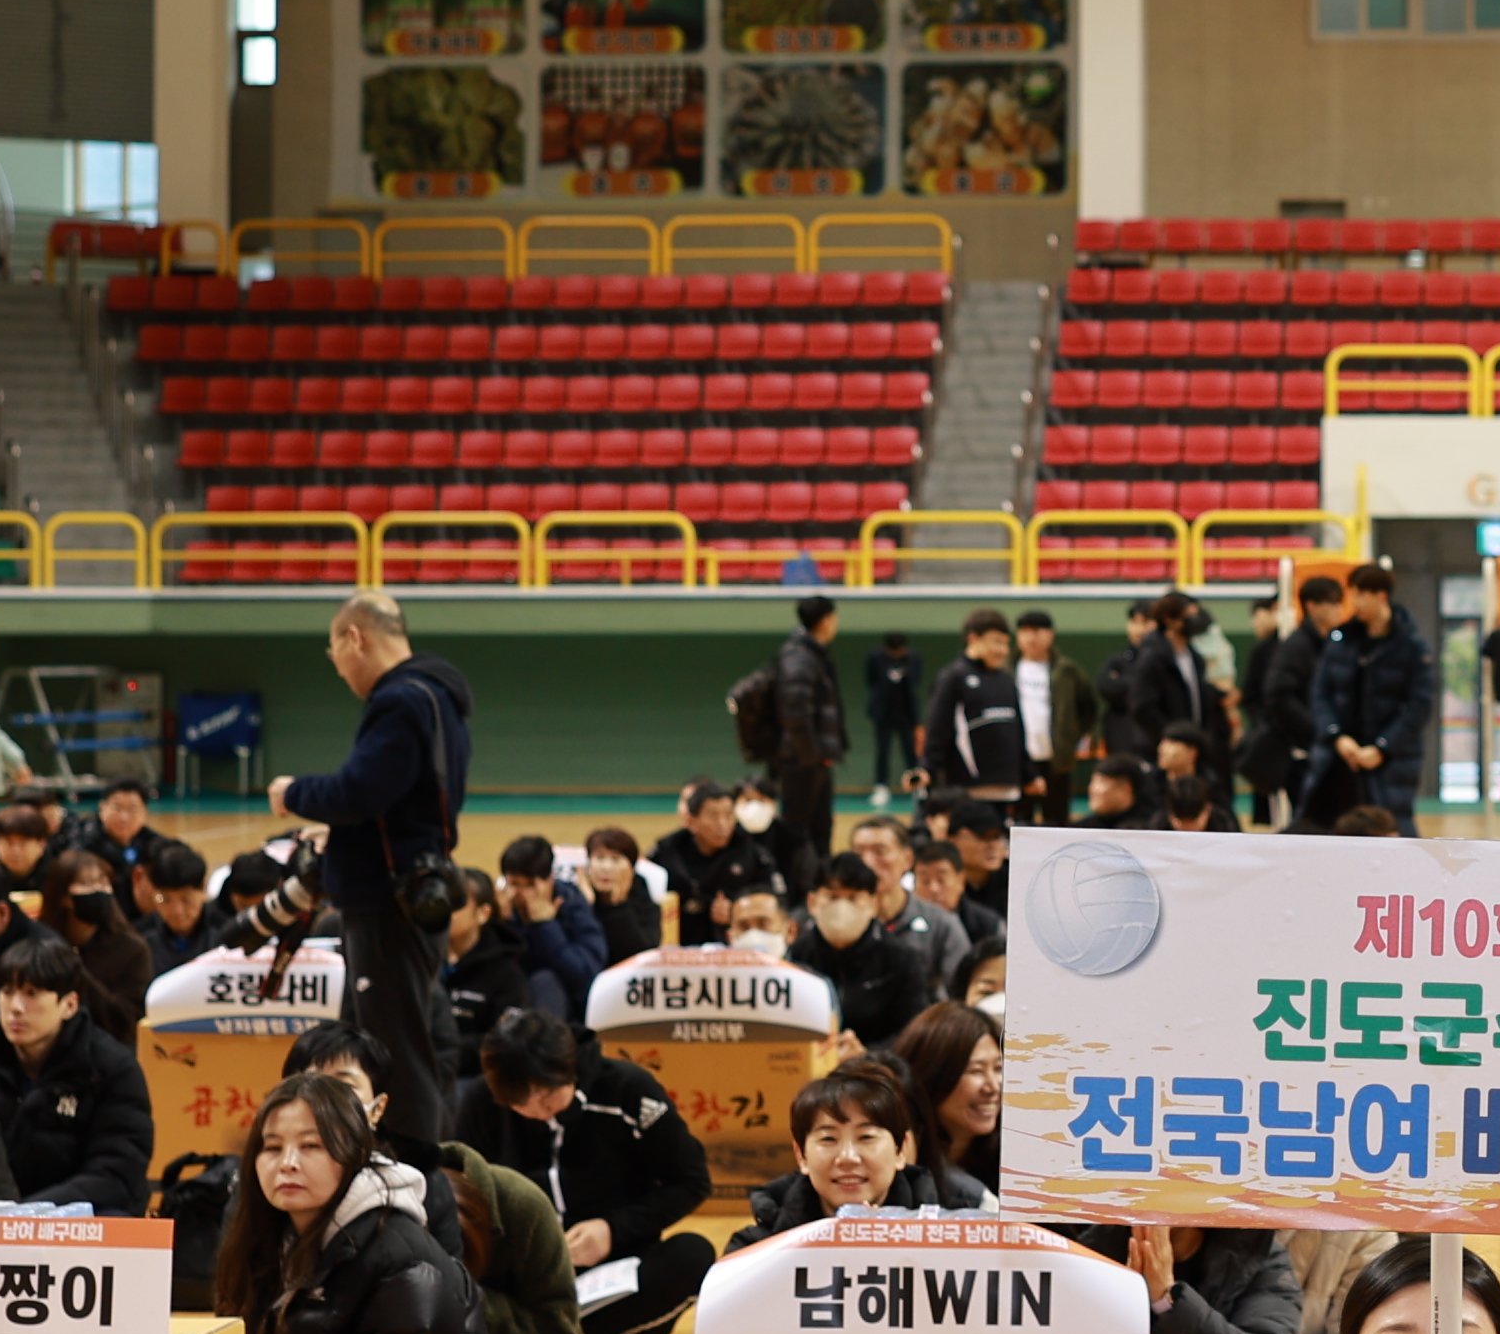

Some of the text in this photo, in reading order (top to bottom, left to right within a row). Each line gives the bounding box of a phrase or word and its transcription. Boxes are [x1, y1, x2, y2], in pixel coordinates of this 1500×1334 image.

[625, 976, 792, 1009] 해남시니어
[1067, 1074, 1430, 1178] 전국남여
[2, 1220, 35, 1240] 남여
[37, 1220, 104, 1241] 배구대회
[839, 1223, 924, 1243] 진도군수배
[927, 1224, 961, 1243] 전국
[965, 1224, 998, 1244] 남여
[794, 1265, 1053, 1329] 남해WIN
